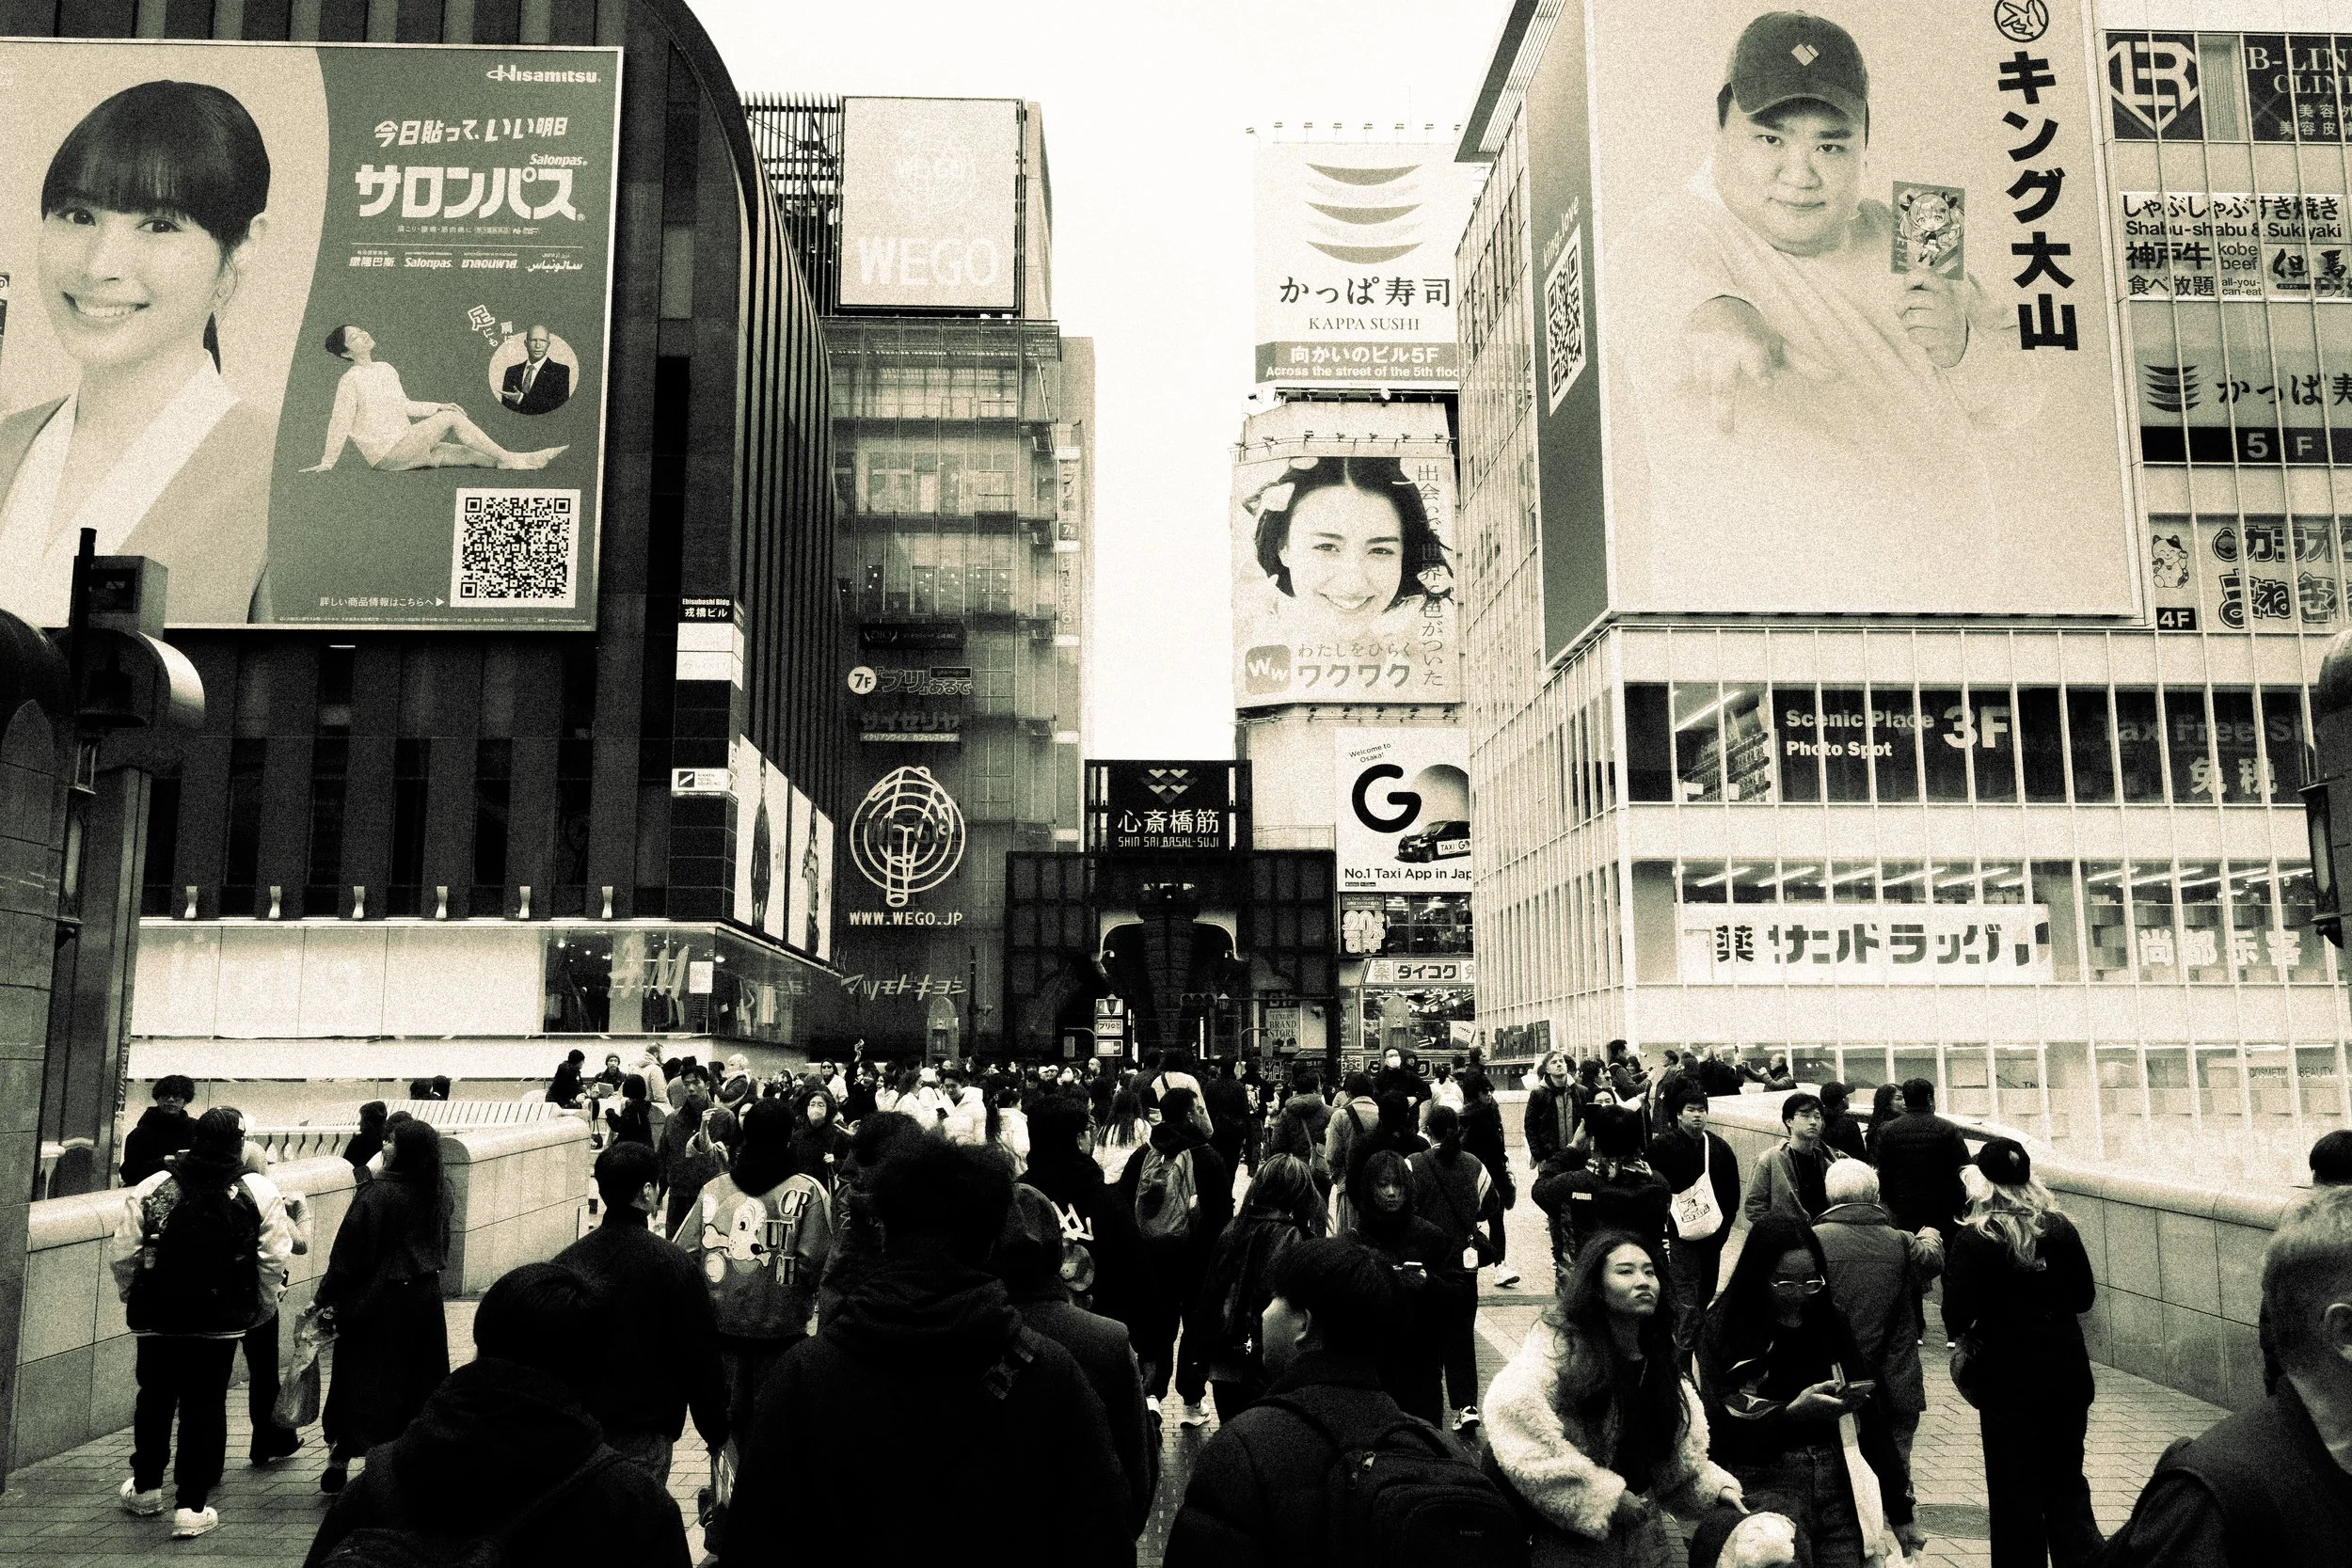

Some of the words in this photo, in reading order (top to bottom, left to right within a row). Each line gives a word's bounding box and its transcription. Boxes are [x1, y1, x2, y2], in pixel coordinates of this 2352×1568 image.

[2246, 46, 2352, 71] B-LIN
[485, 65, 598, 83] Hisamitsu
[529, 152, 584, 166] Salonpas
[355, 164, 577, 222] サロンパス
[1996, 50, 2079, 351] キング大山
[2125, 220, 2247, 237] Shabu-shabu
[2267, 221, 2343, 239] Sukiyaki
[2125, 241, 2214, 271] 神戸牛
[2217, 242, 2258, 256] kobe
[404, 257, 453, 269] Salonpas
[858, 236, 1000, 286] WEGO
[2220, 257, 2258, 271] beef
[1279, 276, 1451, 308] かっぱ寿司
[2127, 274, 2215, 296] 食べ放題
[2221, 287, 2263, 296] can-eat
[1309, 316, 1365, 330] KAPPA
[1370, 316, 1420, 330] SUSHI
[1291, 345, 1439, 365] 向かいのビル5F
[1265, 366, 1309, 378] Across
[1312, 366, 1331, 377] the
[1335, 366, 1369, 378] street
[1371, 366, 1387, 378] of
[1391, 366, 1410, 378] the
[1413, 366, 1433, 378] 5th
[319, 596, 435, 608] 詳しい商品情報はこちらへ
[682, 597, 715, 606] Ebisubashi
[684, 607, 728, 619] 戎橋ビル
[2159, 611, 2191, 627] 4F
[1297, 642, 1414, 658] わたしをひらく
[852, 673, 873, 689] 7F
[1297, 662, 1410, 689] ワクワク
[1786, 709, 1863, 728] Scenic
[1871, 709, 1935, 729] Place
[1942, 705, 2010, 750] 3F
[1348, 745, 1381, 759] Welcome
[1382, 741, 1391, 751] to
[1359, 752, 1385, 764] Osaka!
[1786, 741, 1843, 756] Photo
[1847, 741, 1892, 759] Spot
[2188, 756, 2279, 796] 免税
[1117, 808, 1220, 835] 心斎橋筋
[1118, 836, 1140, 847] SHIN
[1143, 836, 1159, 847] SAI
[1440, 843, 1456, 852] TAXI
[1343, 867, 1371, 880] No.1
[1374, 867, 1402, 880] Taxi
[1405, 867, 1433, 882] App
[1436, 867, 1448, 879] in
[1450, 868, 1471, 882] Jap
[849, 911, 963, 927] WWW.WEGO.JP
[1716, 924, 1755, 963] 薬
[1767, 923, 2003, 965] サンドラッグ
[1397, 963, 1457, 980] ダイコク
[840, 974, 967, 1001] マツモトキヨシ
[1269, 1020, 1296, 1029] BRAND
[1269, 1029, 1295, 1037] STORE
[2298, 1066, 2334, 1078] BEAUTY
[1571, 1191, 1593, 1201] PUMA
